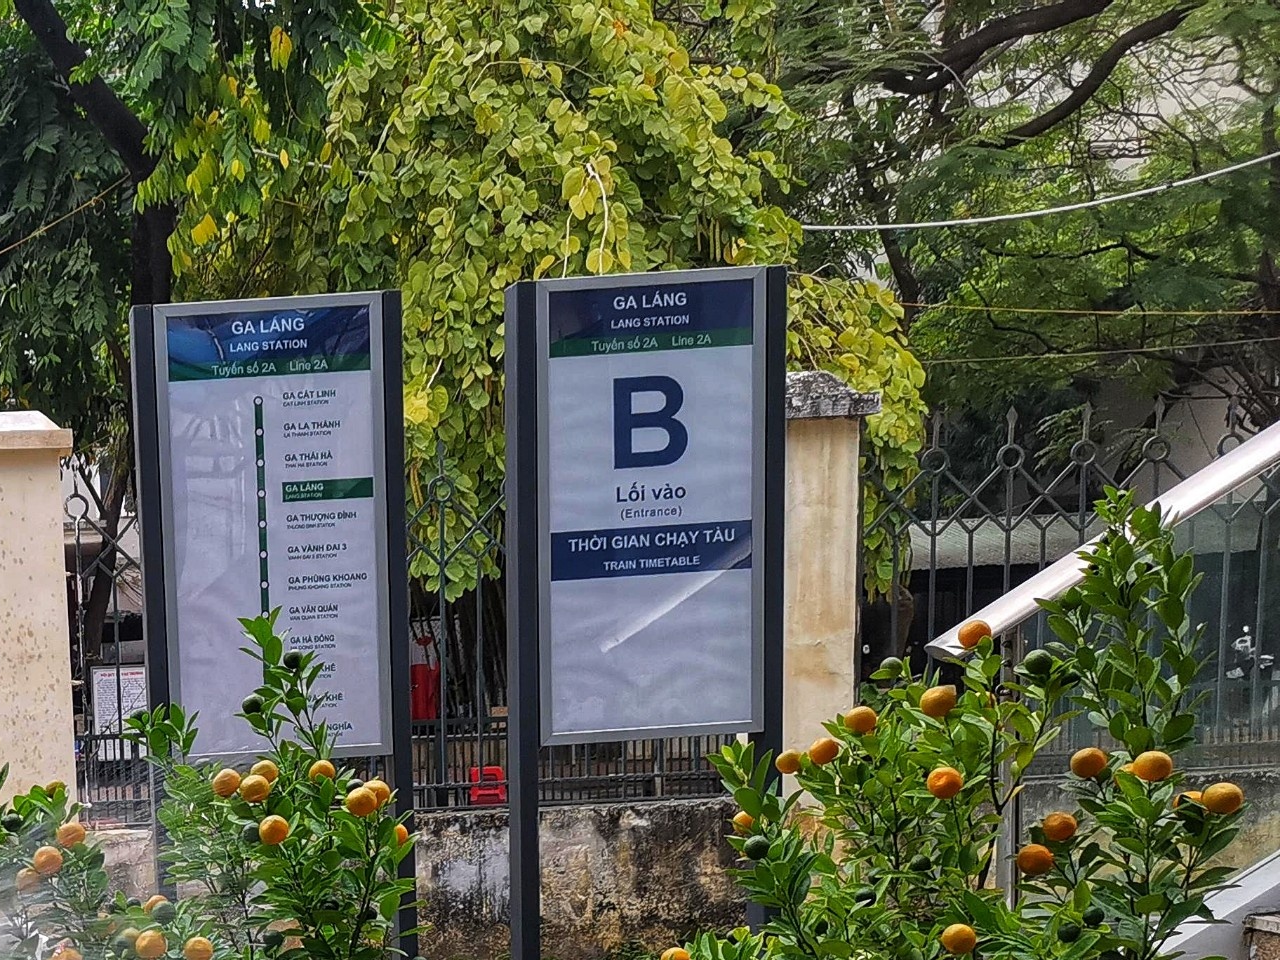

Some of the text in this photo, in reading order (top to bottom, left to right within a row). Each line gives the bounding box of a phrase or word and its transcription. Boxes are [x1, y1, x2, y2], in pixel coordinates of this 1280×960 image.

[613, 291, 687, 310] GA LÁNG
[231, 315, 305, 335] GA LÁNG
[611, 314, 690, 329] LANG STATION
[229, 339, 308, 352] LANG STATION
[591, 334, 712, 354] Tuyến số 2A Line 2A
[211, 359, 328, 377] Tuyến số 2A Line 2A
[282, 392, 296, 400] GA
[316, 389, 336, 398] LINH
[283, 422, 296, 431] GA
[298, 422, 310, 430] LA
[613, 375, 689, 470] B
[284, 453, 298, 461] GA
[285, 484, 299, 492] GA
[616, 481, 687, 503] Lối vào
[286, 514, 299, 522] GA
[620, 505, 683, 521] (Entrance)
[568, 526, 736, 552] THỜI GIAN CHẠY TÀU
[287, 545, 300, 553] GA
[603, 555, 701, 571] TRAIN TIMETABLE
[288, 576, 300, 584] GA
[289, 606, 301, 614] GA
[290, 636, 301, 644] GA
